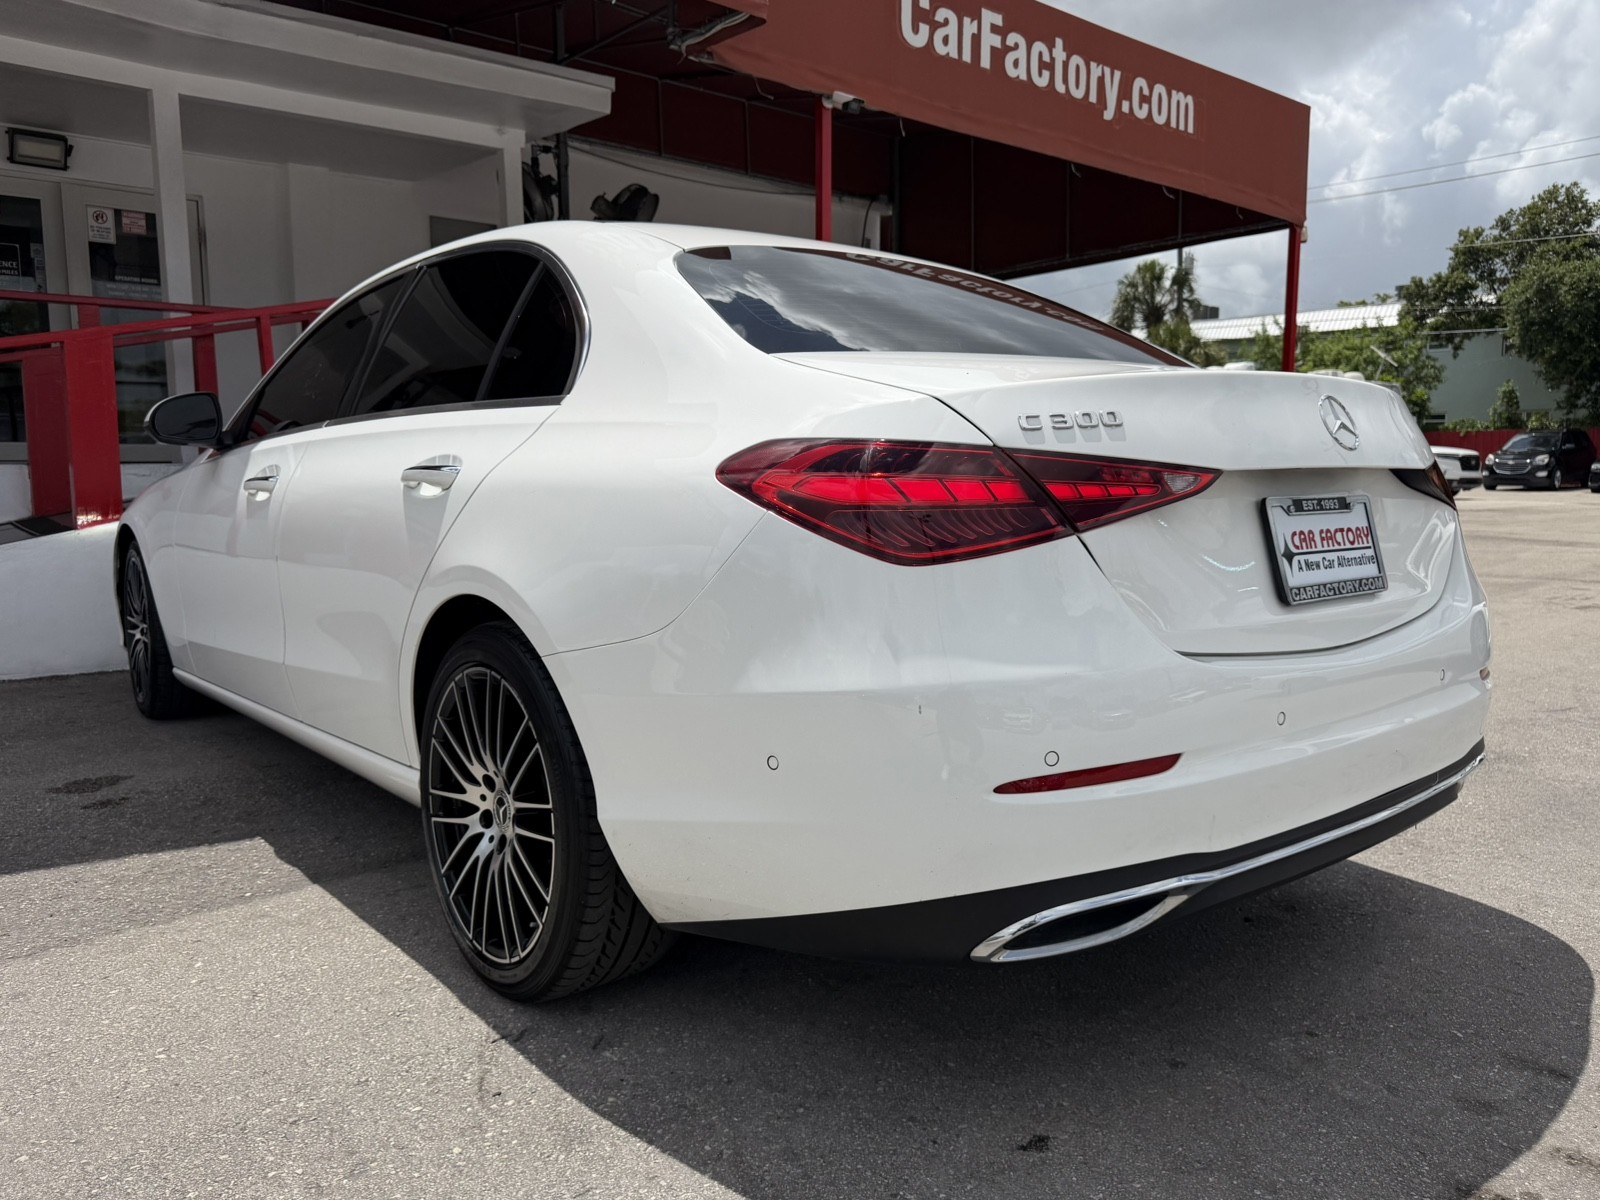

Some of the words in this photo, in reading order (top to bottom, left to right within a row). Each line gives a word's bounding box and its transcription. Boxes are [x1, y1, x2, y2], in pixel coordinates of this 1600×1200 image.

[901, 0, 1194, 134] CarFactory.com
[1018, 412, 1043, 431] C
[1049, 410, 1124, 430] 300
[1302, 500, 1320, 510] EST.
[1322, 499, 1339, 509] 1993
[1291, 529, 1318, 551] CAR
[1319, 526, 1370, 548] FACTORY
[1298, 559, 1304, 573] A
[1304, 558, 1321, 572] New
[1322, 556, 1336, 570] Car
[1337, 553, 1376, 569] Alternative
[1291, 577, 1384, 601] CARFACTORY.COM
